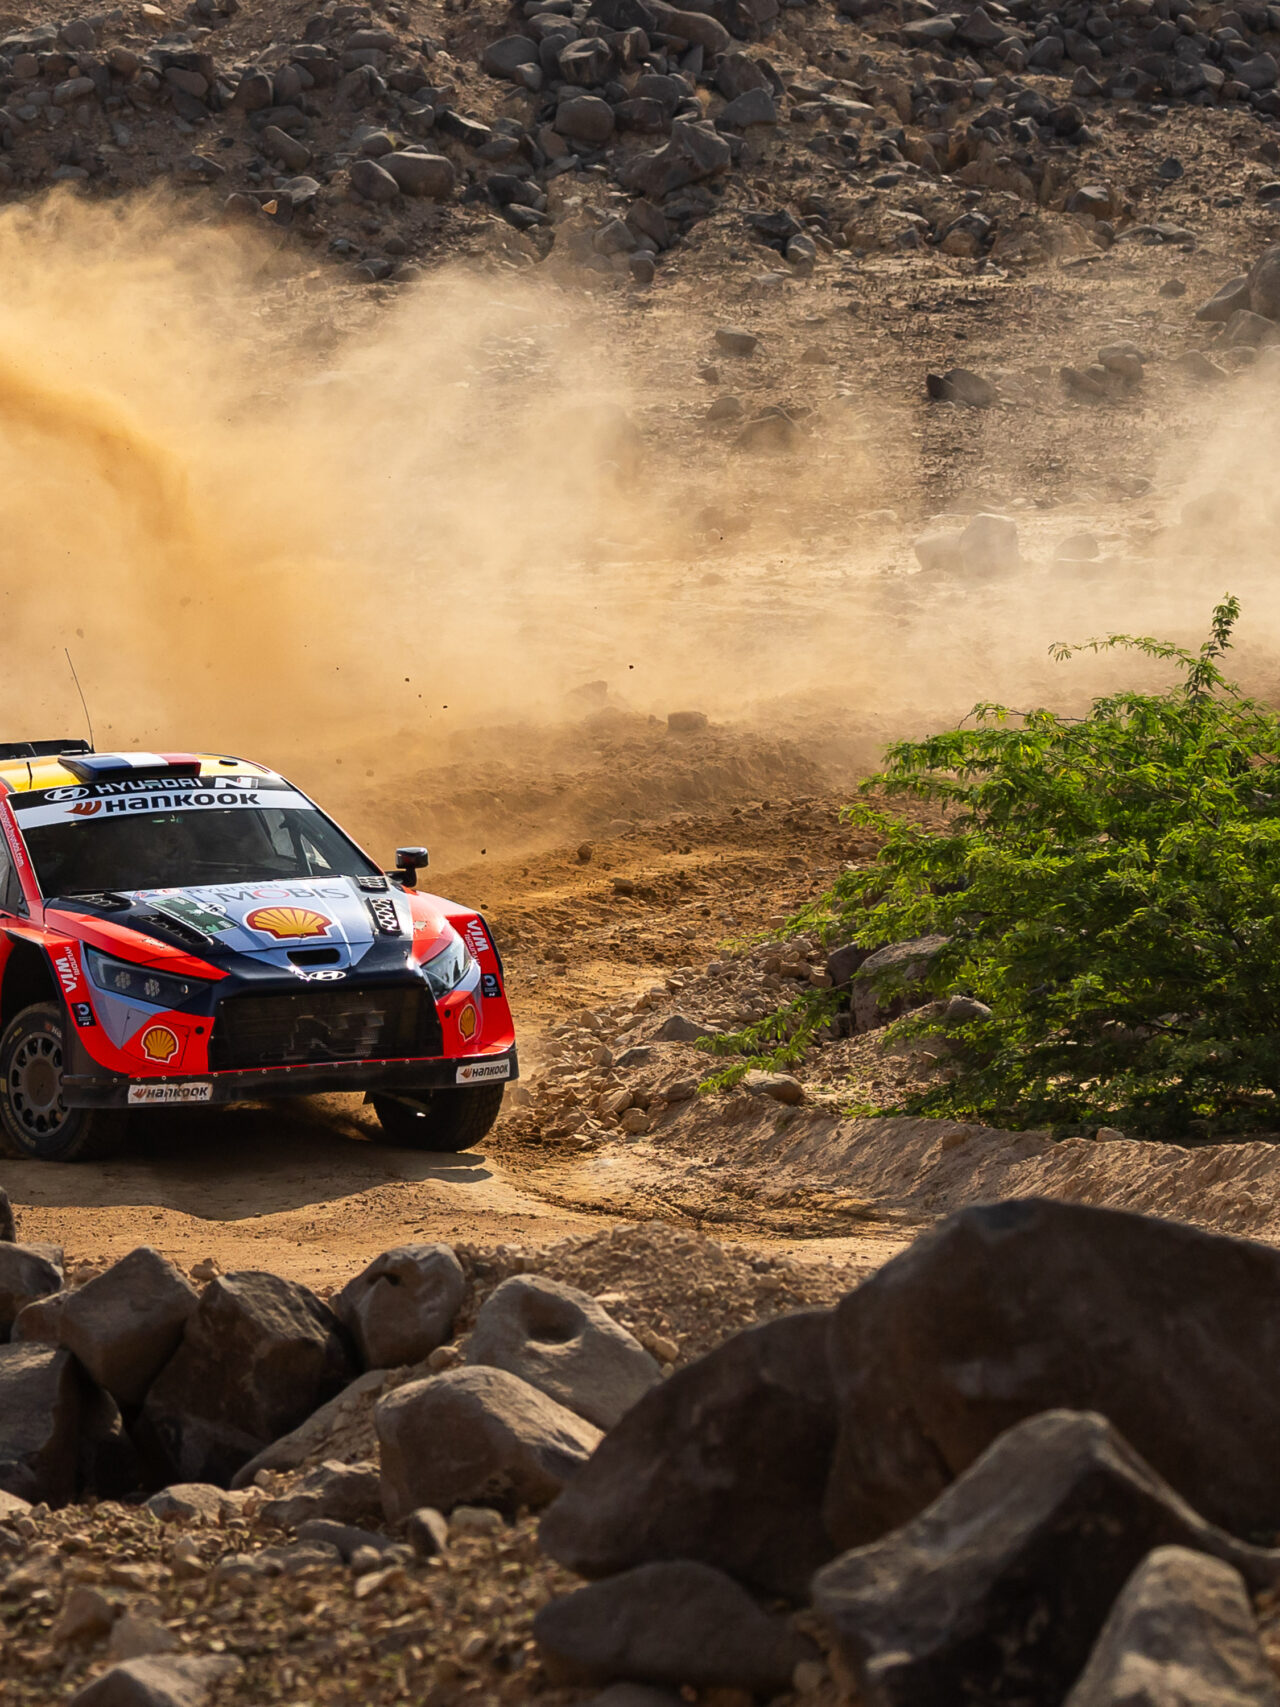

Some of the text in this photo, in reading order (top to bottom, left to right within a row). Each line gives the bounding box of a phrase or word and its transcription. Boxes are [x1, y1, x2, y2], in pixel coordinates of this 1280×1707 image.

[95, 777, 203, 795] HYUNDAI
[217, 887, 350, 903] MOBIS
[466, 919, 489, 952] WIA
[55, 957, 78, 993] WIA
[64, 946, 80, 976] HYUNDAI
